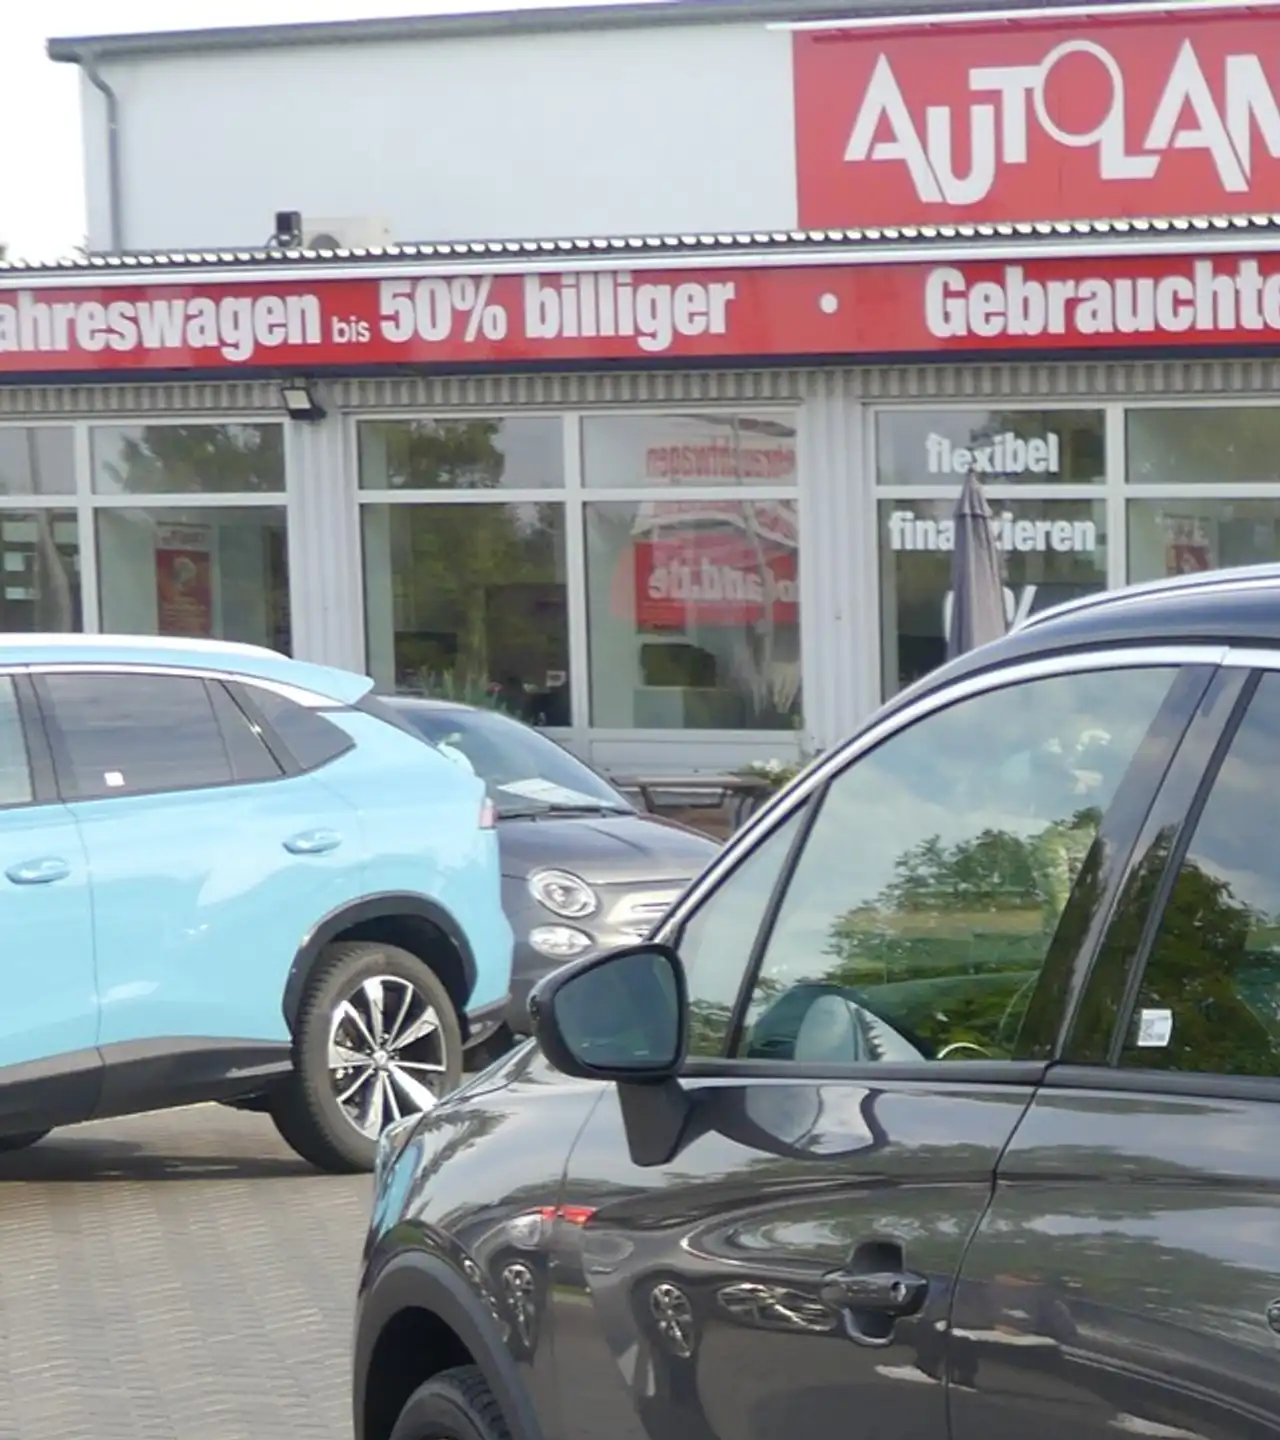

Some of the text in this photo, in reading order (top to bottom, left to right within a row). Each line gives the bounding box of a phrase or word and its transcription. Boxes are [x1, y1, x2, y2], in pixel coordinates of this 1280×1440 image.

[332, 310, 371, 344] bis
[379, 275, 508, 342] 50%
[524, 272, 735, 352] billiger
[926, 431, 1059, 474] flexibel
